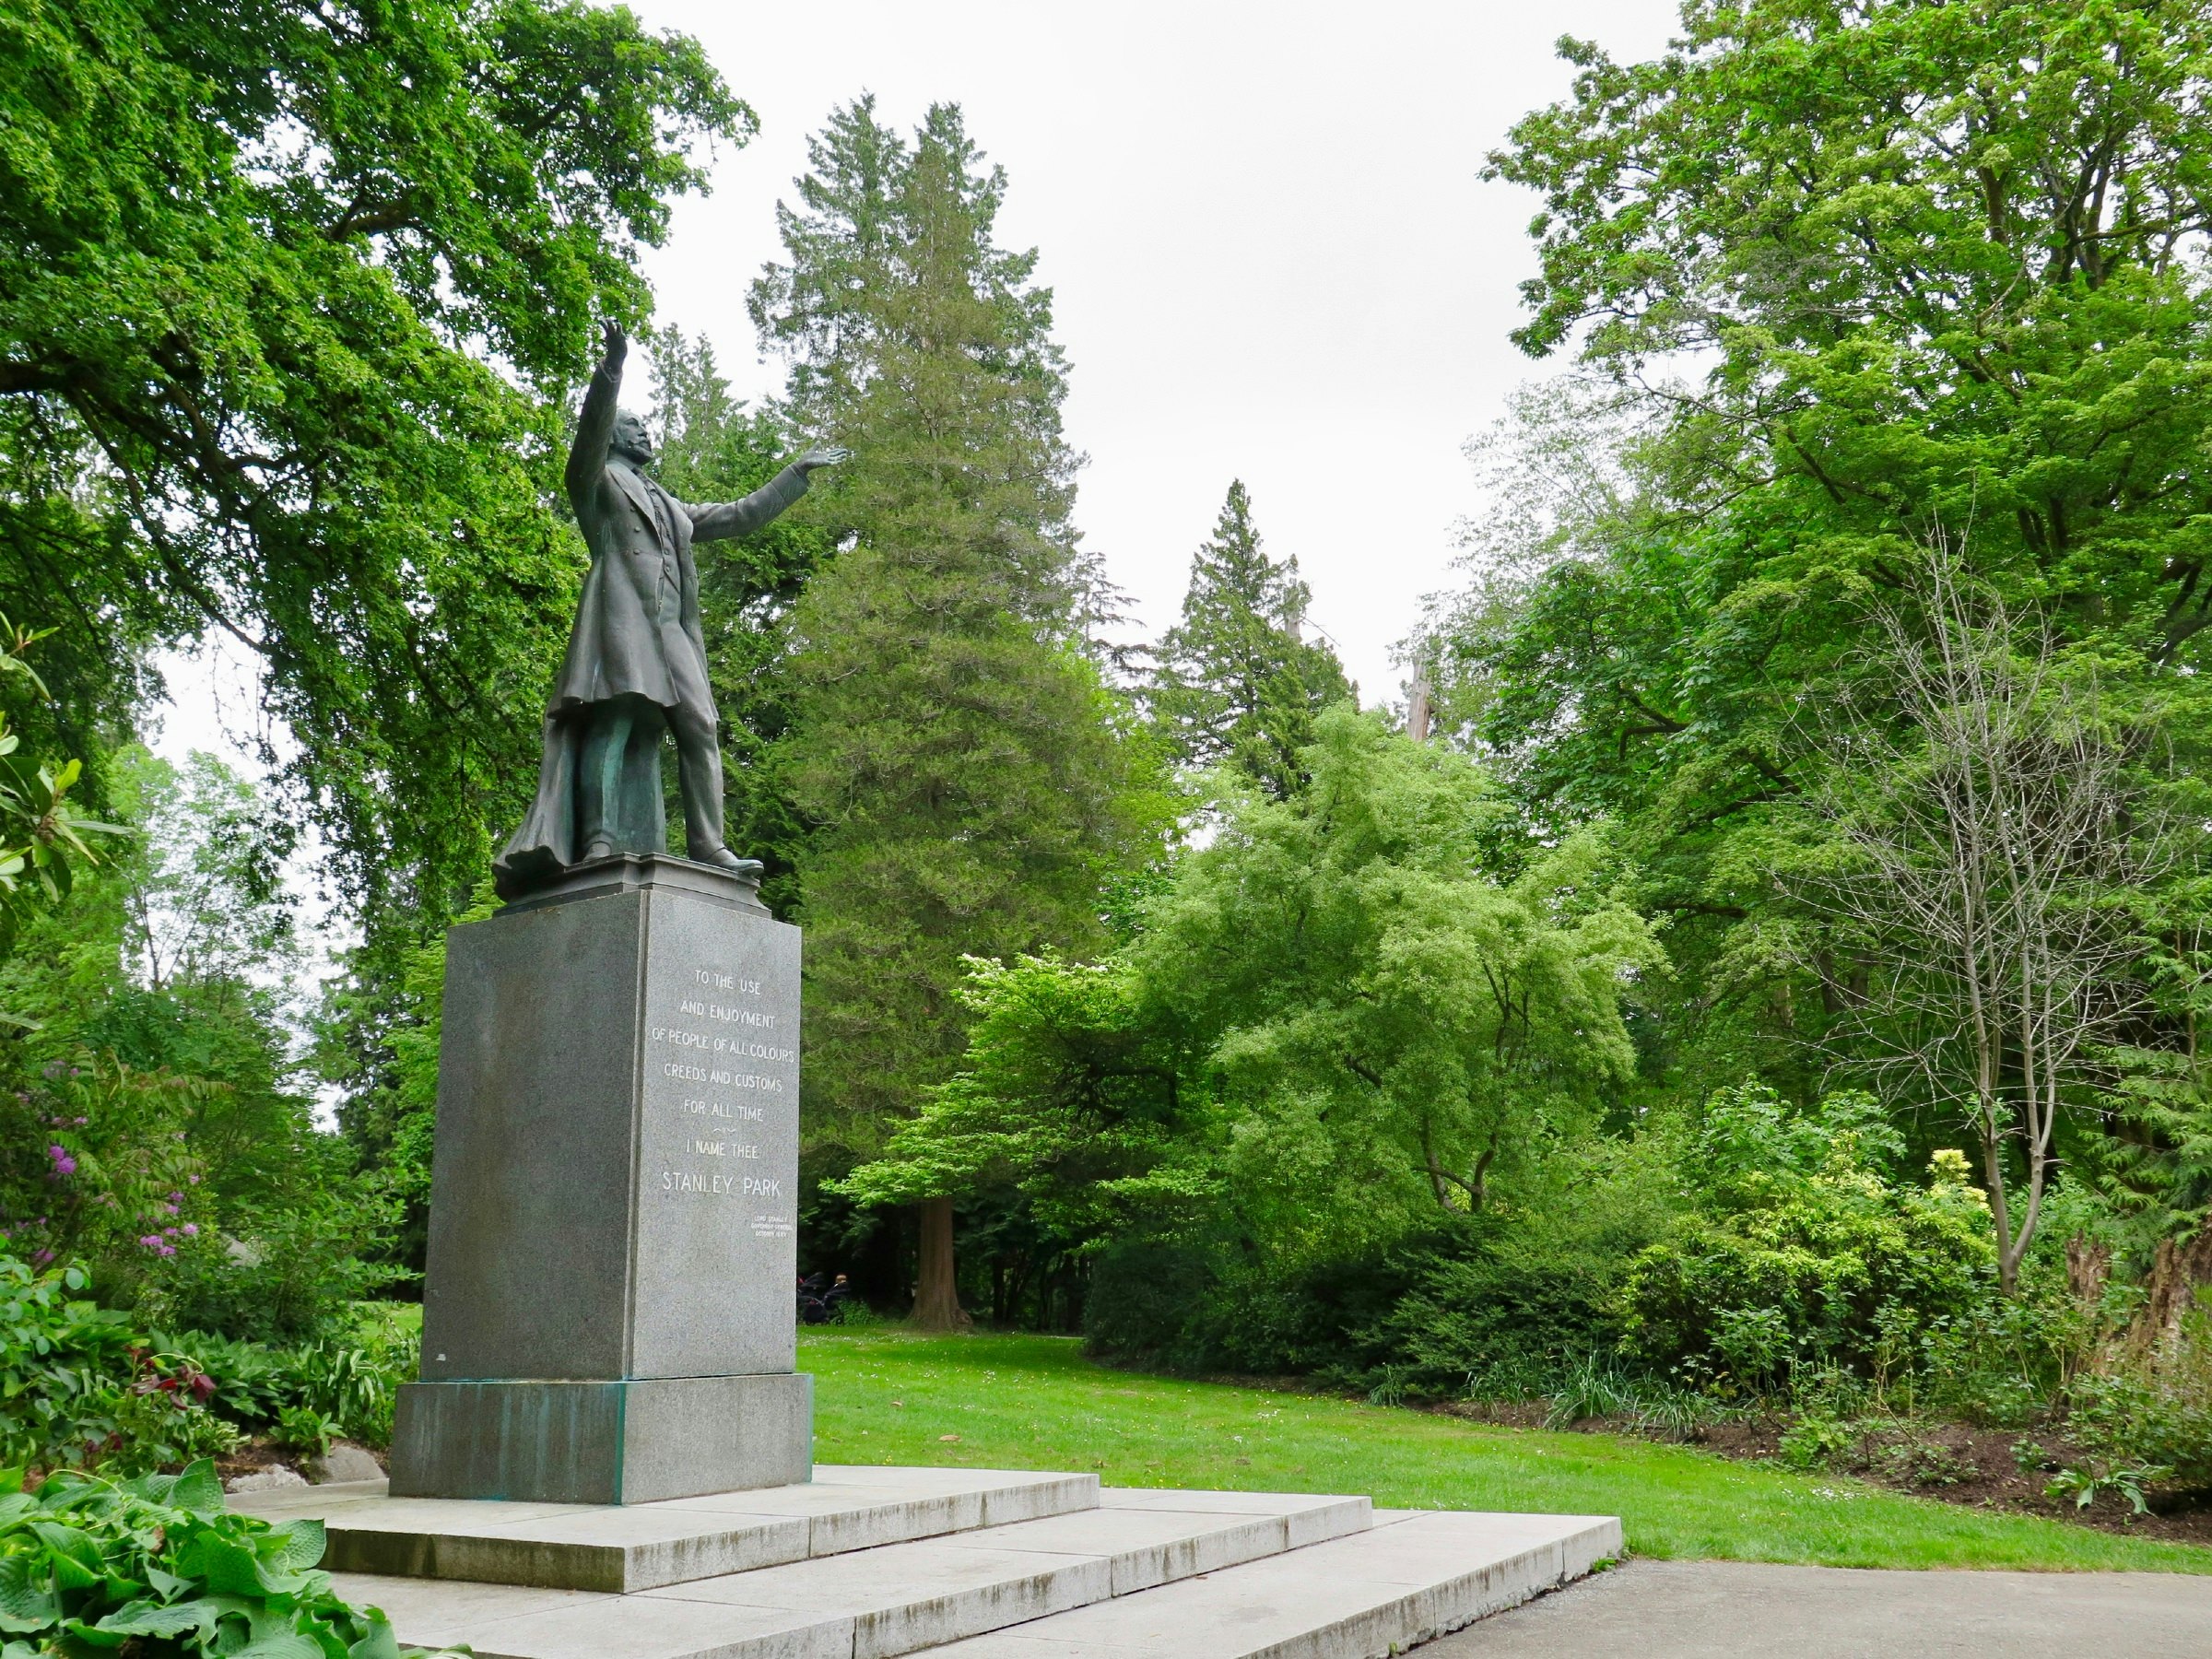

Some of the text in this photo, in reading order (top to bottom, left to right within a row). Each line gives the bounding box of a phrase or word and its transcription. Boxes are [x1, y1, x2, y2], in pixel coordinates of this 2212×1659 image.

[695, 970, 761, 995] TO THE USE
[680, 1000, 776, 1029] AND ENJOYMENT
[652, 1027, 794, 1064] OF PEOPLE OF ALL COLOURS
[664, 1063, 782, 1092] CREEDS AND CUSTOMS
[684, 1100, 764, 1122] FOR ALL TIME
[686, 1138, 759, 1159] I NAME THEE
[662, 1171, 782, 1197] STANLEY PARK
